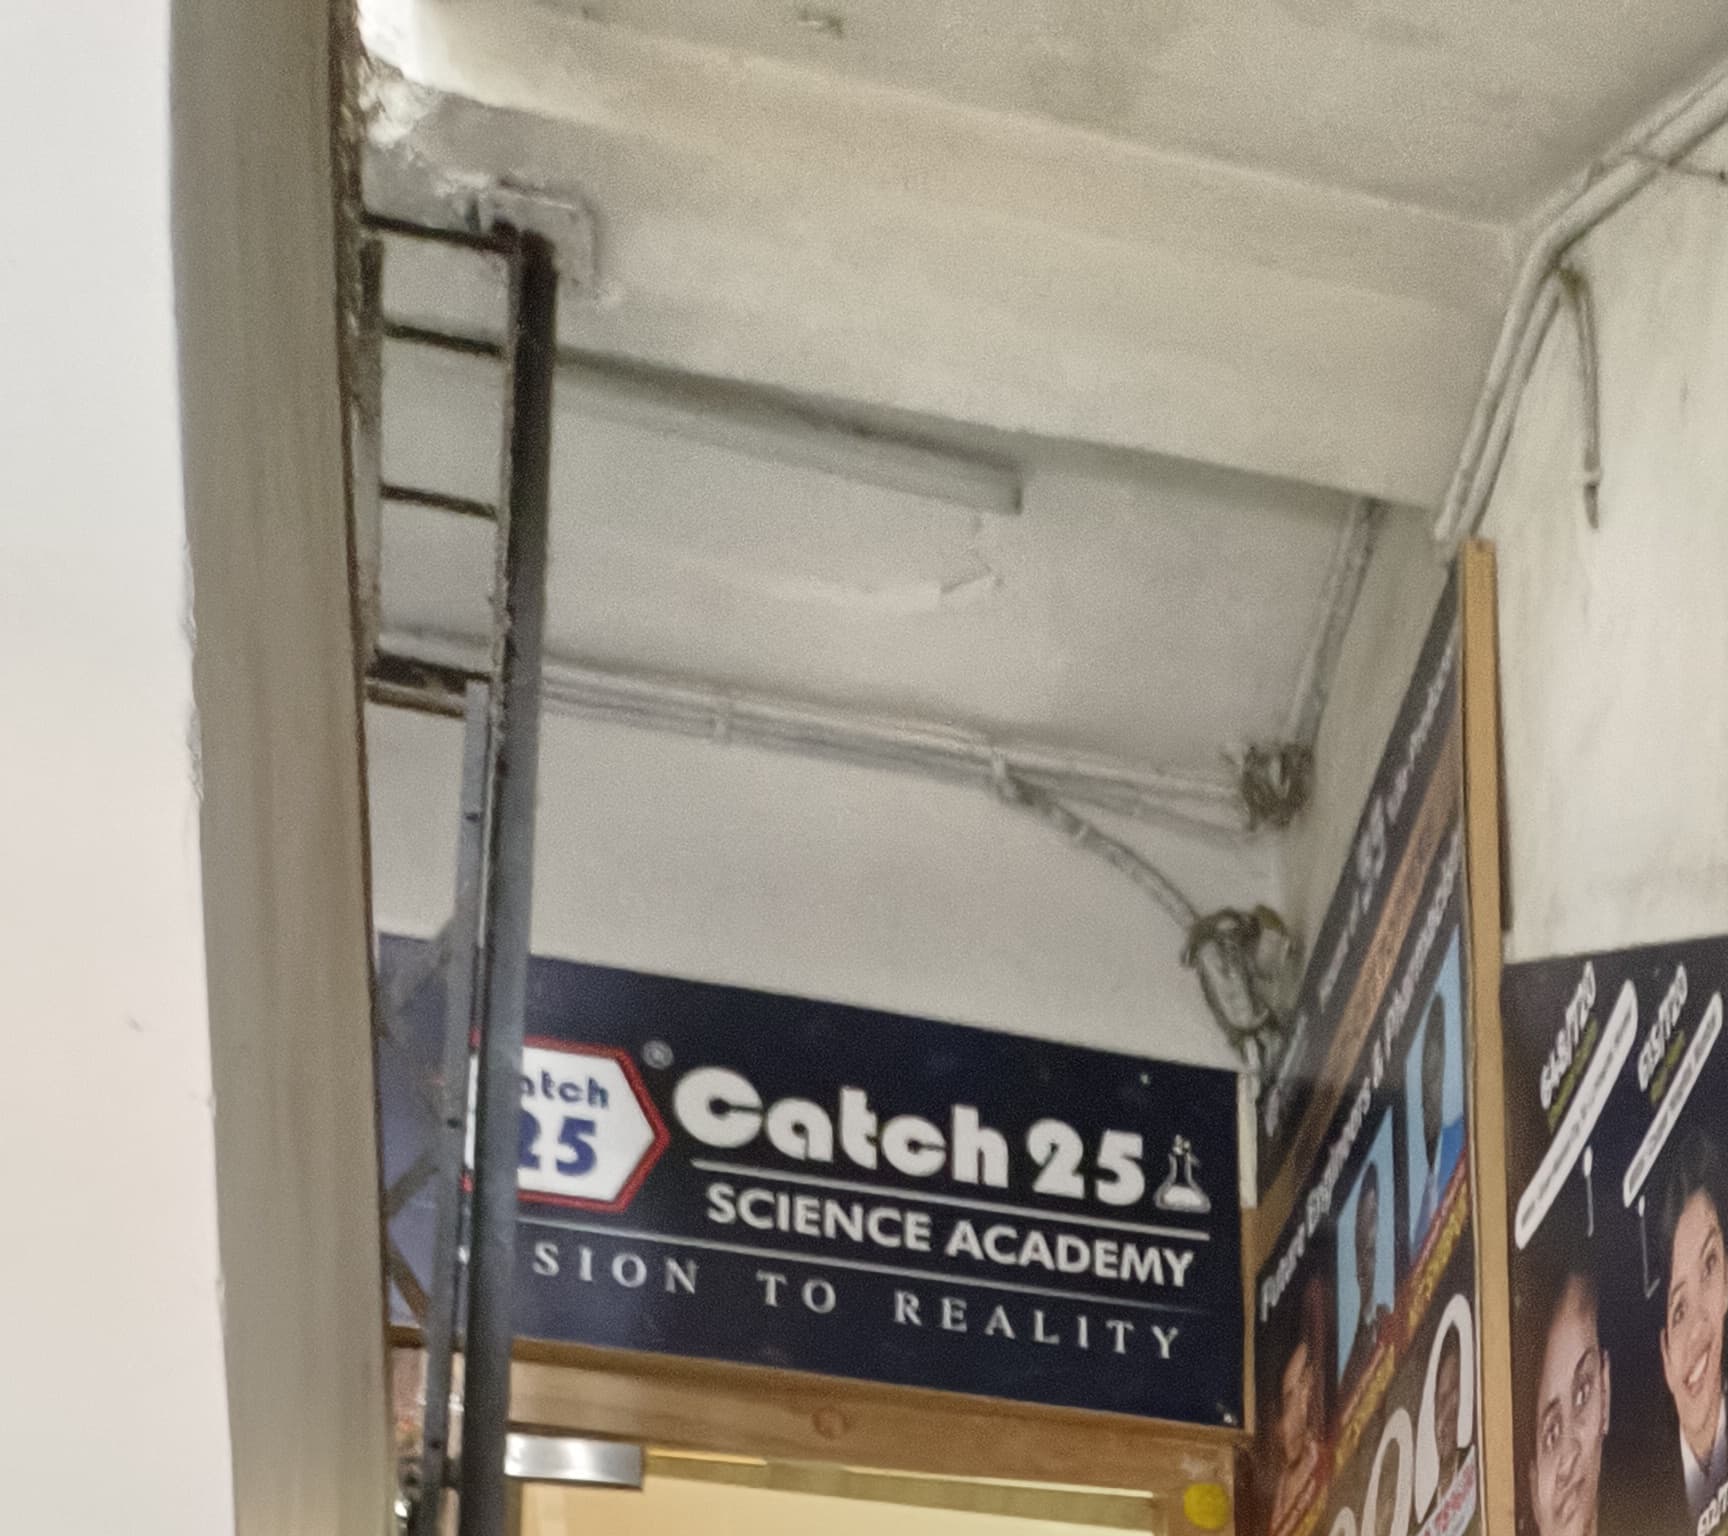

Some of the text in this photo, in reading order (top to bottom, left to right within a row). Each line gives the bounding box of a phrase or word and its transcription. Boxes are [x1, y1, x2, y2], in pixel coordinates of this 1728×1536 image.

[672, 1067, 1145, 1206] Catch 25
[706, 1182, 1197, 1289] SCIENCE ACADEMY
[531, 1242, 1181, 1361] SION TO REALITY
